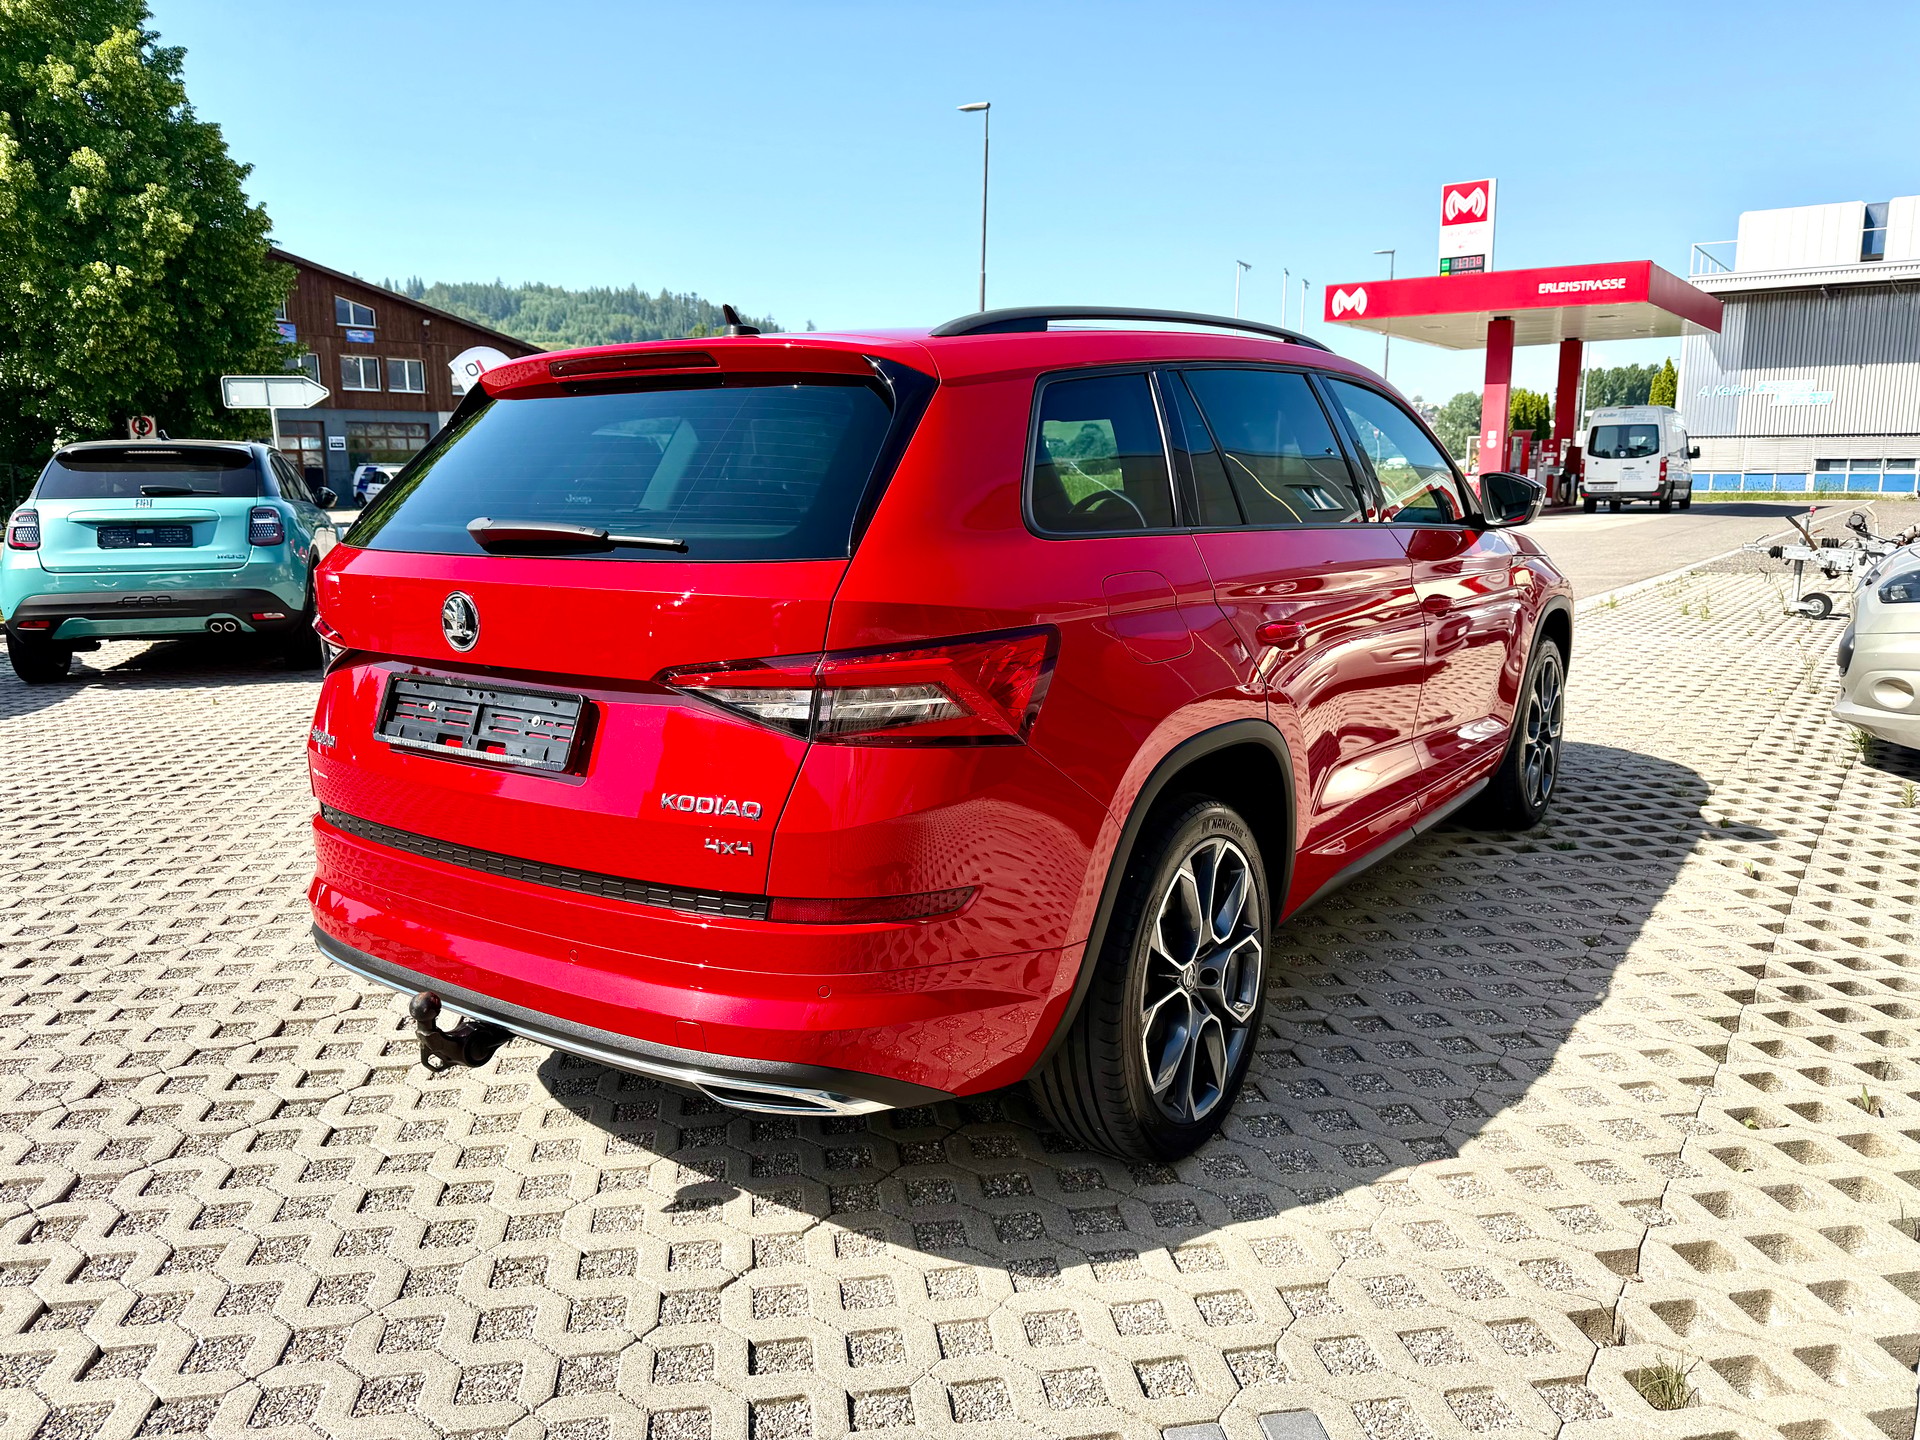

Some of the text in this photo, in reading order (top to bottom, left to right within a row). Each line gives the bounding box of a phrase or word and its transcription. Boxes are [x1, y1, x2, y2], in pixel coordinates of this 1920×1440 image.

[1538, 278, 1627, 294] ERLENSTRASSE
[1711, 384, 1753, 397] Keller
[660, 792, 762, 821] KODIAQ
[1211, 818, 1244, 839] NANKANG
[704, 838, 753, 856] 4x4
